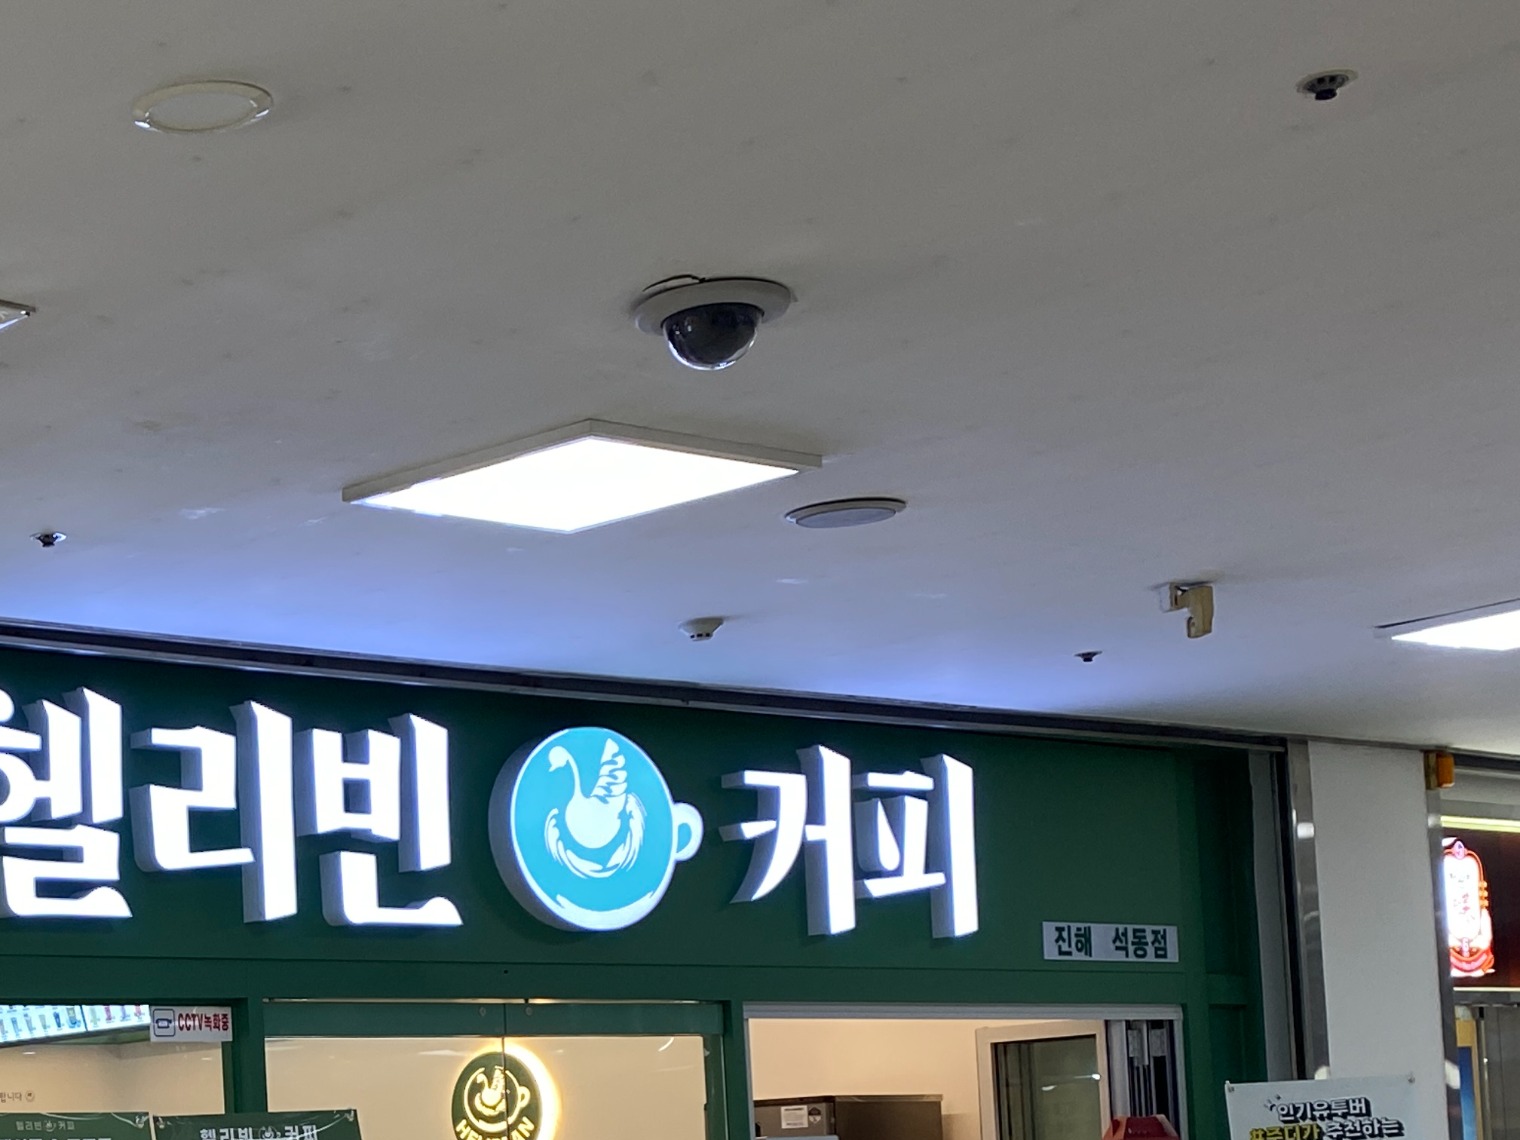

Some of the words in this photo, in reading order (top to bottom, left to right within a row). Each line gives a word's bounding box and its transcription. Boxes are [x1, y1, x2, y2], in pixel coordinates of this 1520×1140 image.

[720, 745, 978, 938] 커피
[1054, 925, 1093, 958] 진해
[1112, 926, 1168, 959] 석동점
[178, 1012, 229, 1033] CCTV녹화중
[1326, 1117, 1404, 1139] 추천하는
